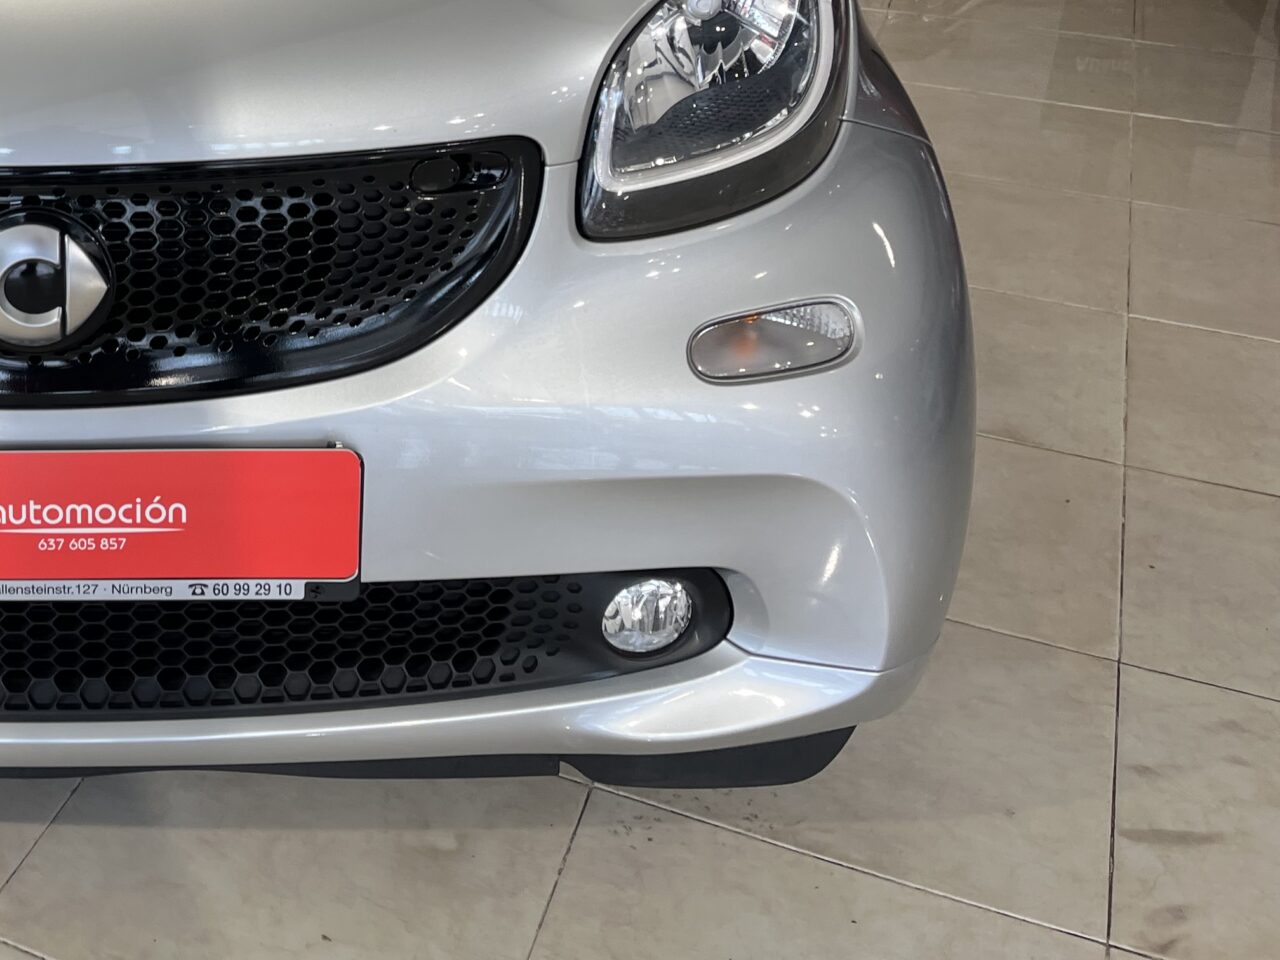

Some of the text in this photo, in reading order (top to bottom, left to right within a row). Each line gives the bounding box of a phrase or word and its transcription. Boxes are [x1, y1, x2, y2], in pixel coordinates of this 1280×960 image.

[38, 537, 127, 551] 637 605 857
[111, 583, 173, 598] Nürnberg
[212, 583, 230, 596] 60
[233, 583, 250, 596] 99
[255, 583, 271, 596] 29
[276, 583, 292, 596] 10
